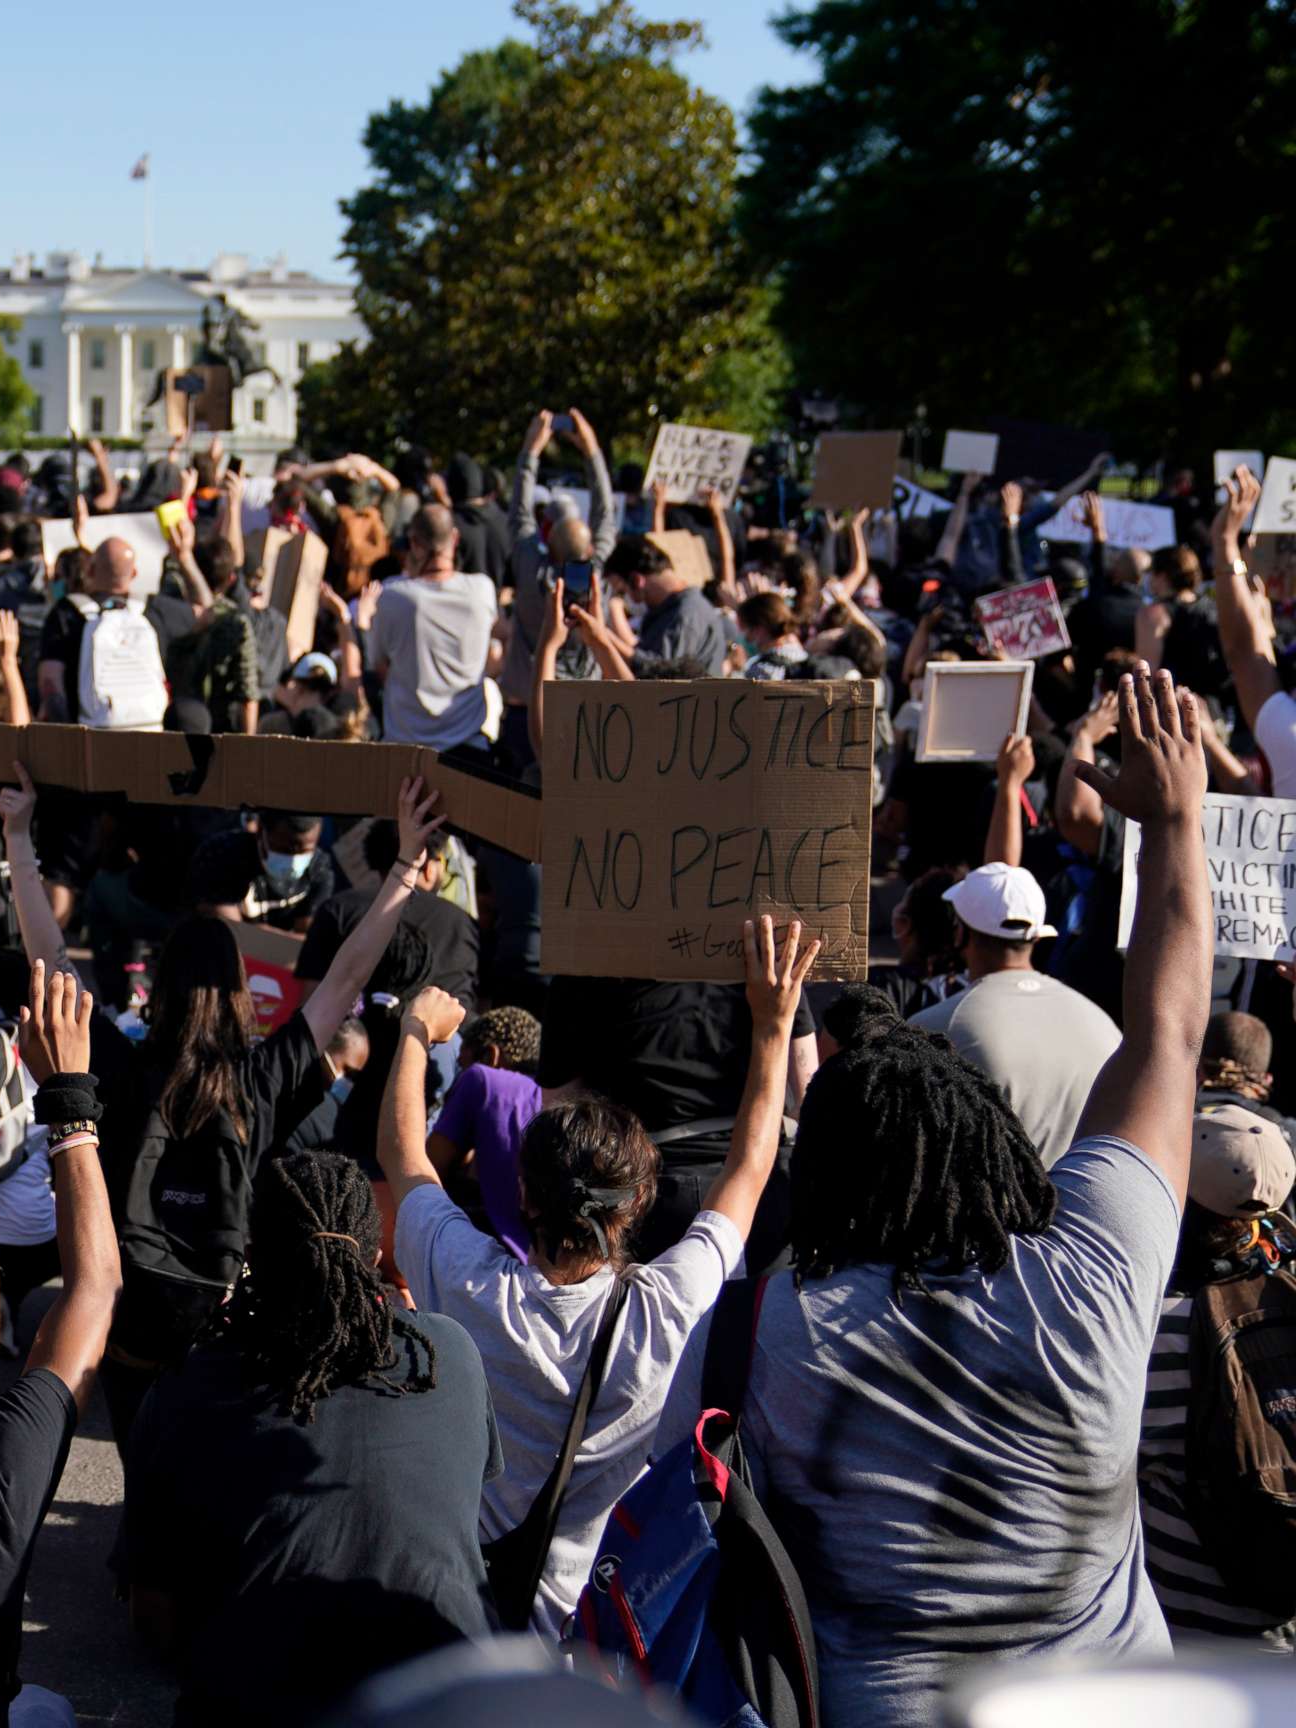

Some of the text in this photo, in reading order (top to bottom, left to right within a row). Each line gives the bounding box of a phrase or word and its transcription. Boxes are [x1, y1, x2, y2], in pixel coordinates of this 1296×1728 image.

[573, 694, 872, 783] NO JUSTICE
[565, 822, 856, 911] NO PEACE
[1211, 890, 1288, 915] HITE
